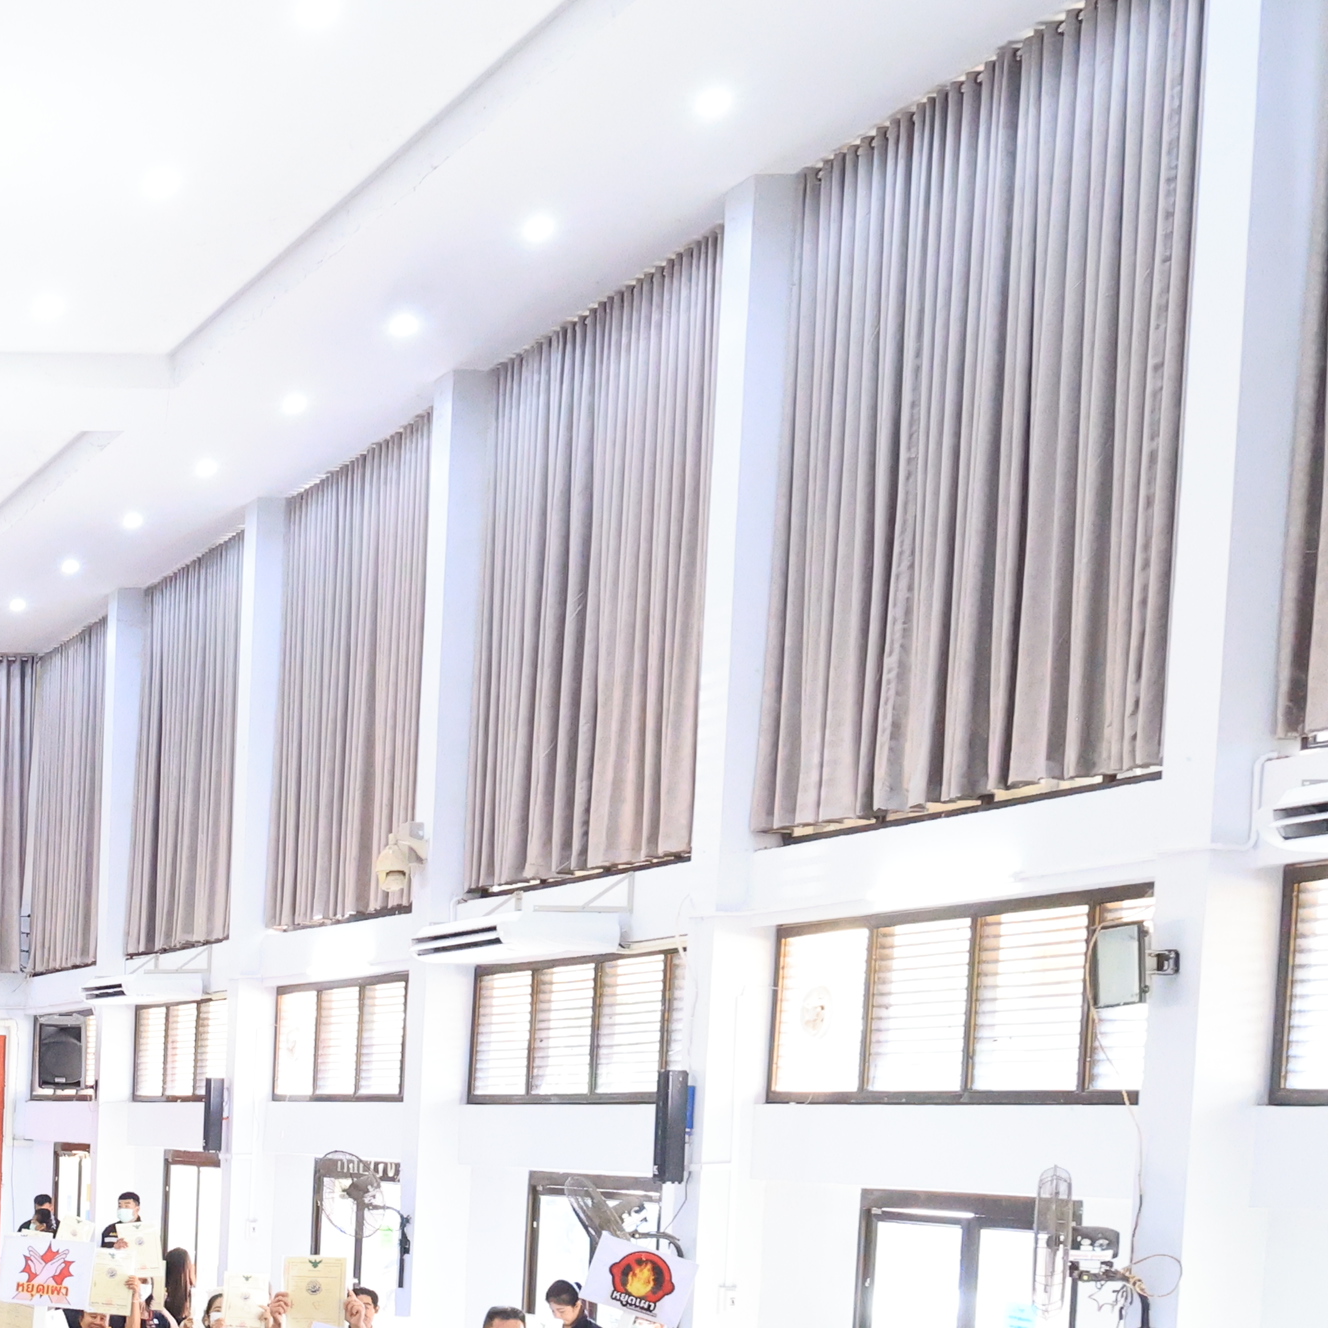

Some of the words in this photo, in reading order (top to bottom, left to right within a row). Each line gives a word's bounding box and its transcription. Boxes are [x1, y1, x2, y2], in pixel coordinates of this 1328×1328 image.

[16, 1282, 69, 1298] หยุดเผา
[612, 1290, 655, 1310] หยุดเผา
